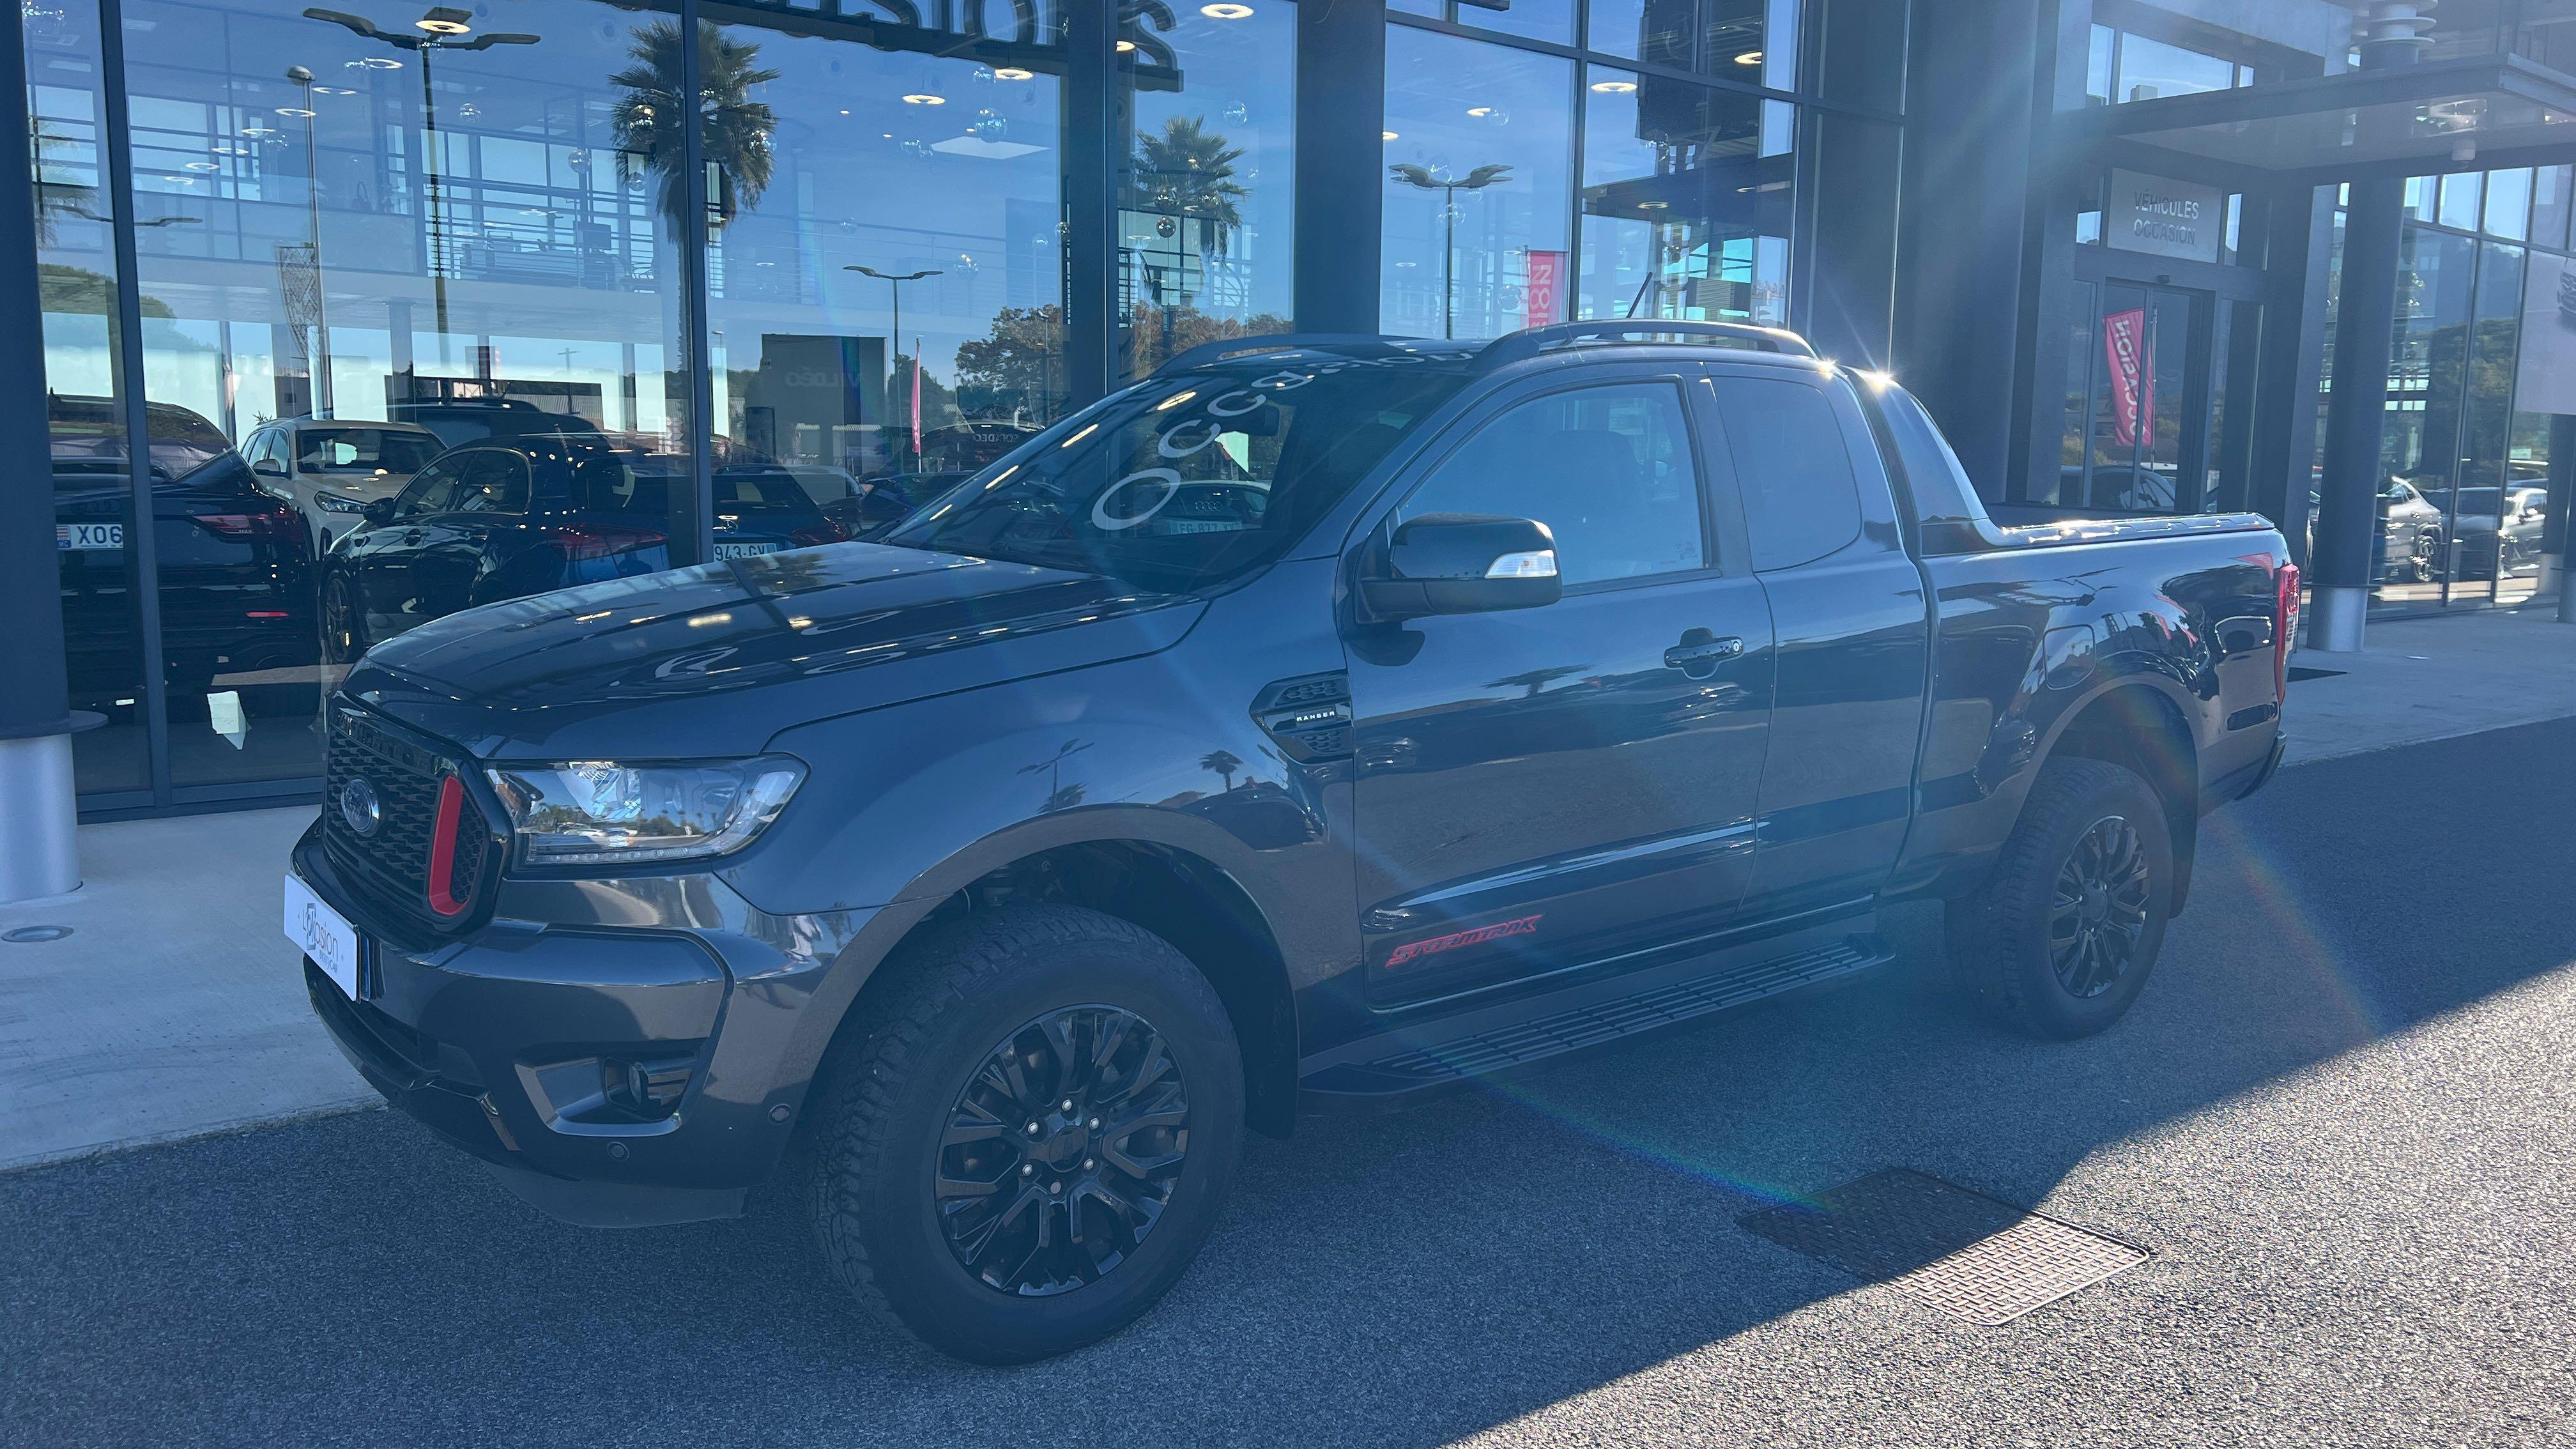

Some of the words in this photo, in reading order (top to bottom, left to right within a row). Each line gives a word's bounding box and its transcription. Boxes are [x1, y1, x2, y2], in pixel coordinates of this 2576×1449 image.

[2135, 188, 2198, 220] VÉHICULES
[2133, 218, 2196, 246] OCCASION
[1296, 710, 1335, 722] RANGER
